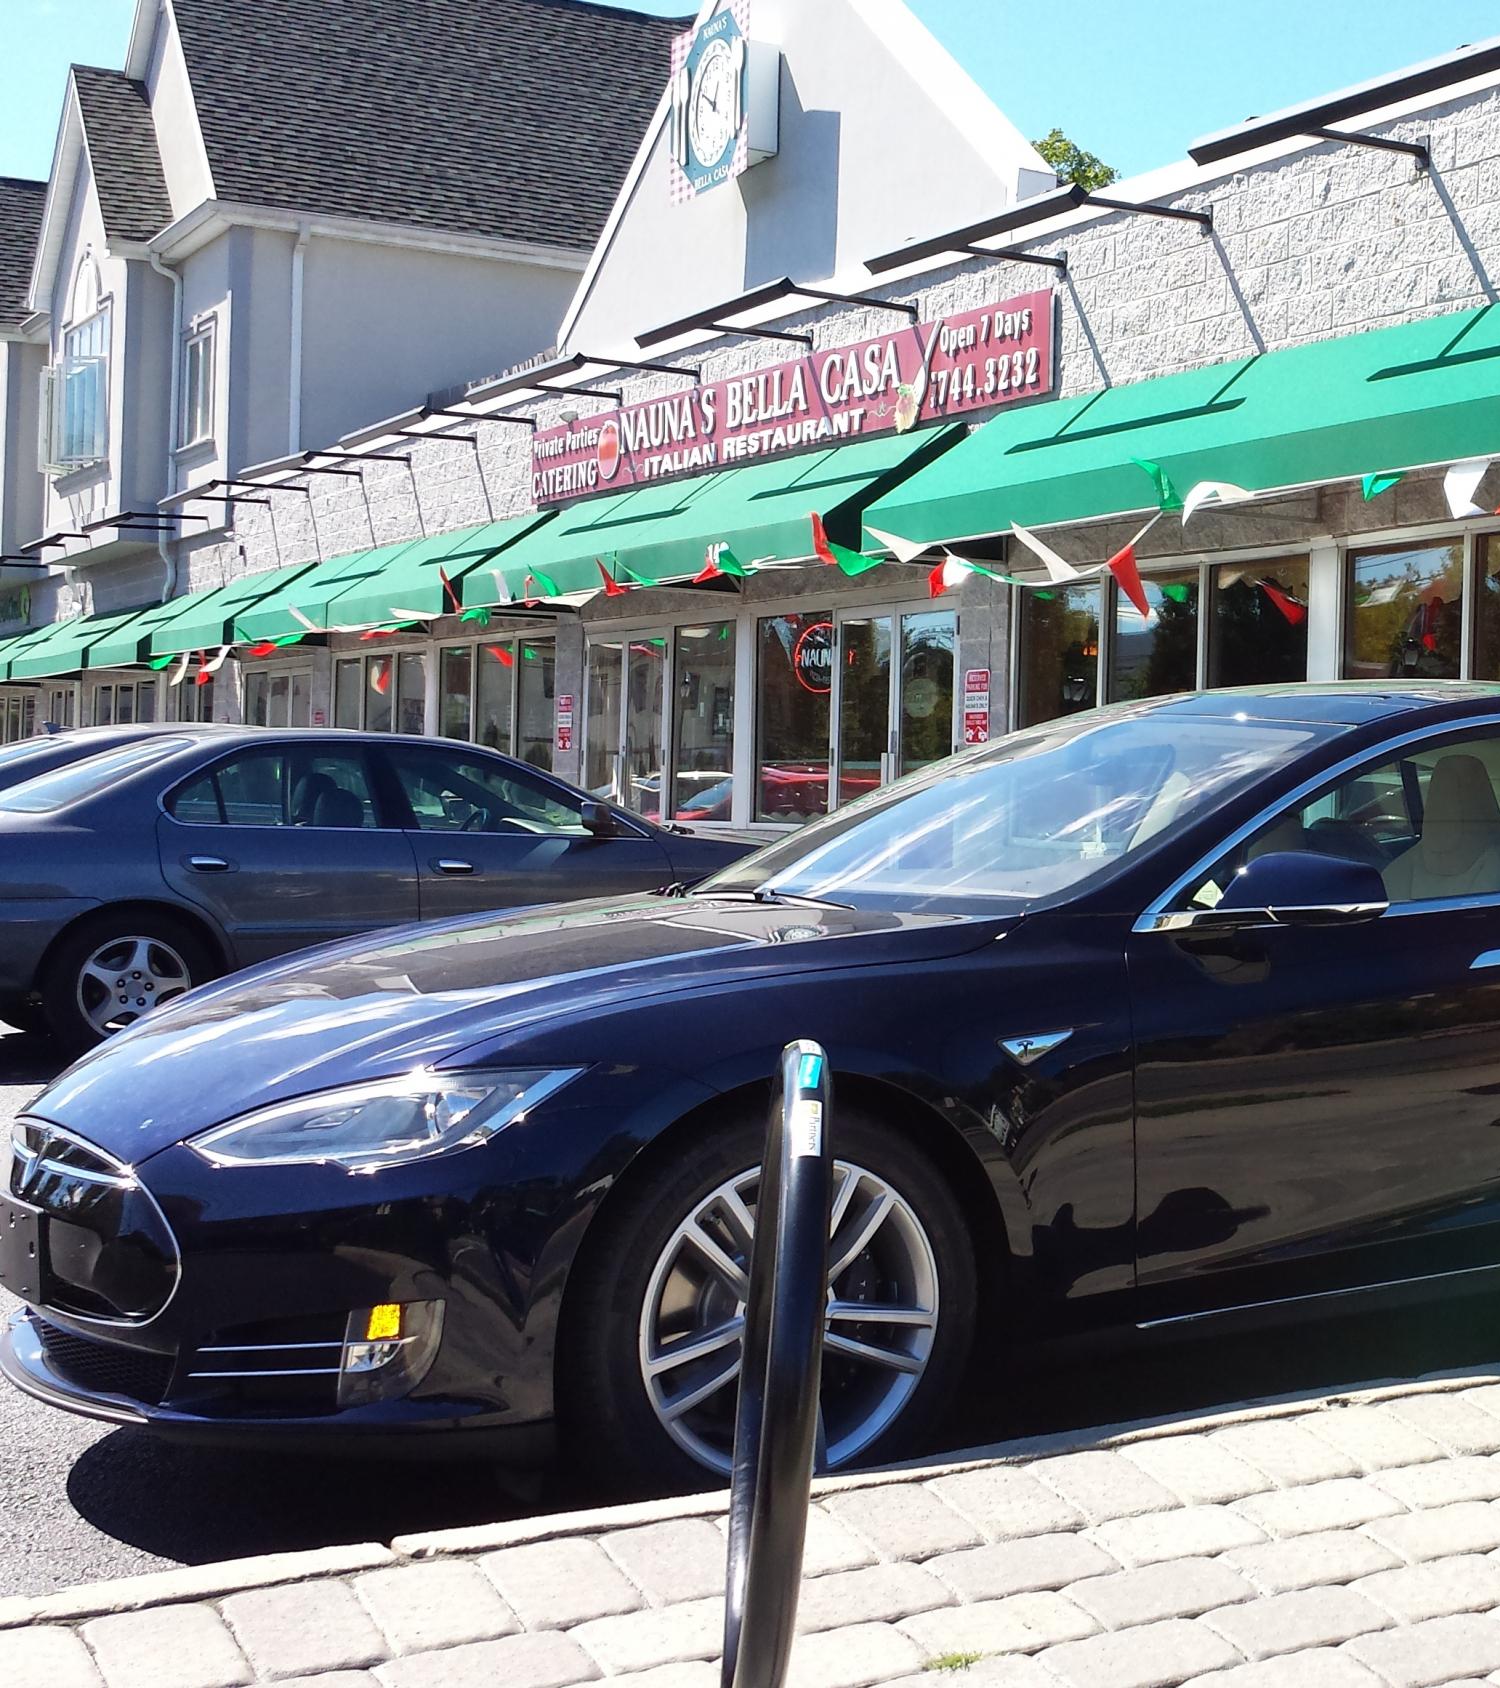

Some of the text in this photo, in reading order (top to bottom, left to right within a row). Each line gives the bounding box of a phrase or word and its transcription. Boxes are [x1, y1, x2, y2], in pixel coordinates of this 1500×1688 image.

[940, 309, 1032, 358] Open 7 Days
[620, 340, 901, 455] NAUNA'S BELLA CASA
[930, 347, 1039, 409] 744.3232
[566, 426, 598, 452] Parties
[644, 407, 865, 478] ITALIAN RESTAURANT
[532, 459, 597, 499] CATERING
[801, 648, 832, 668] NAUN
